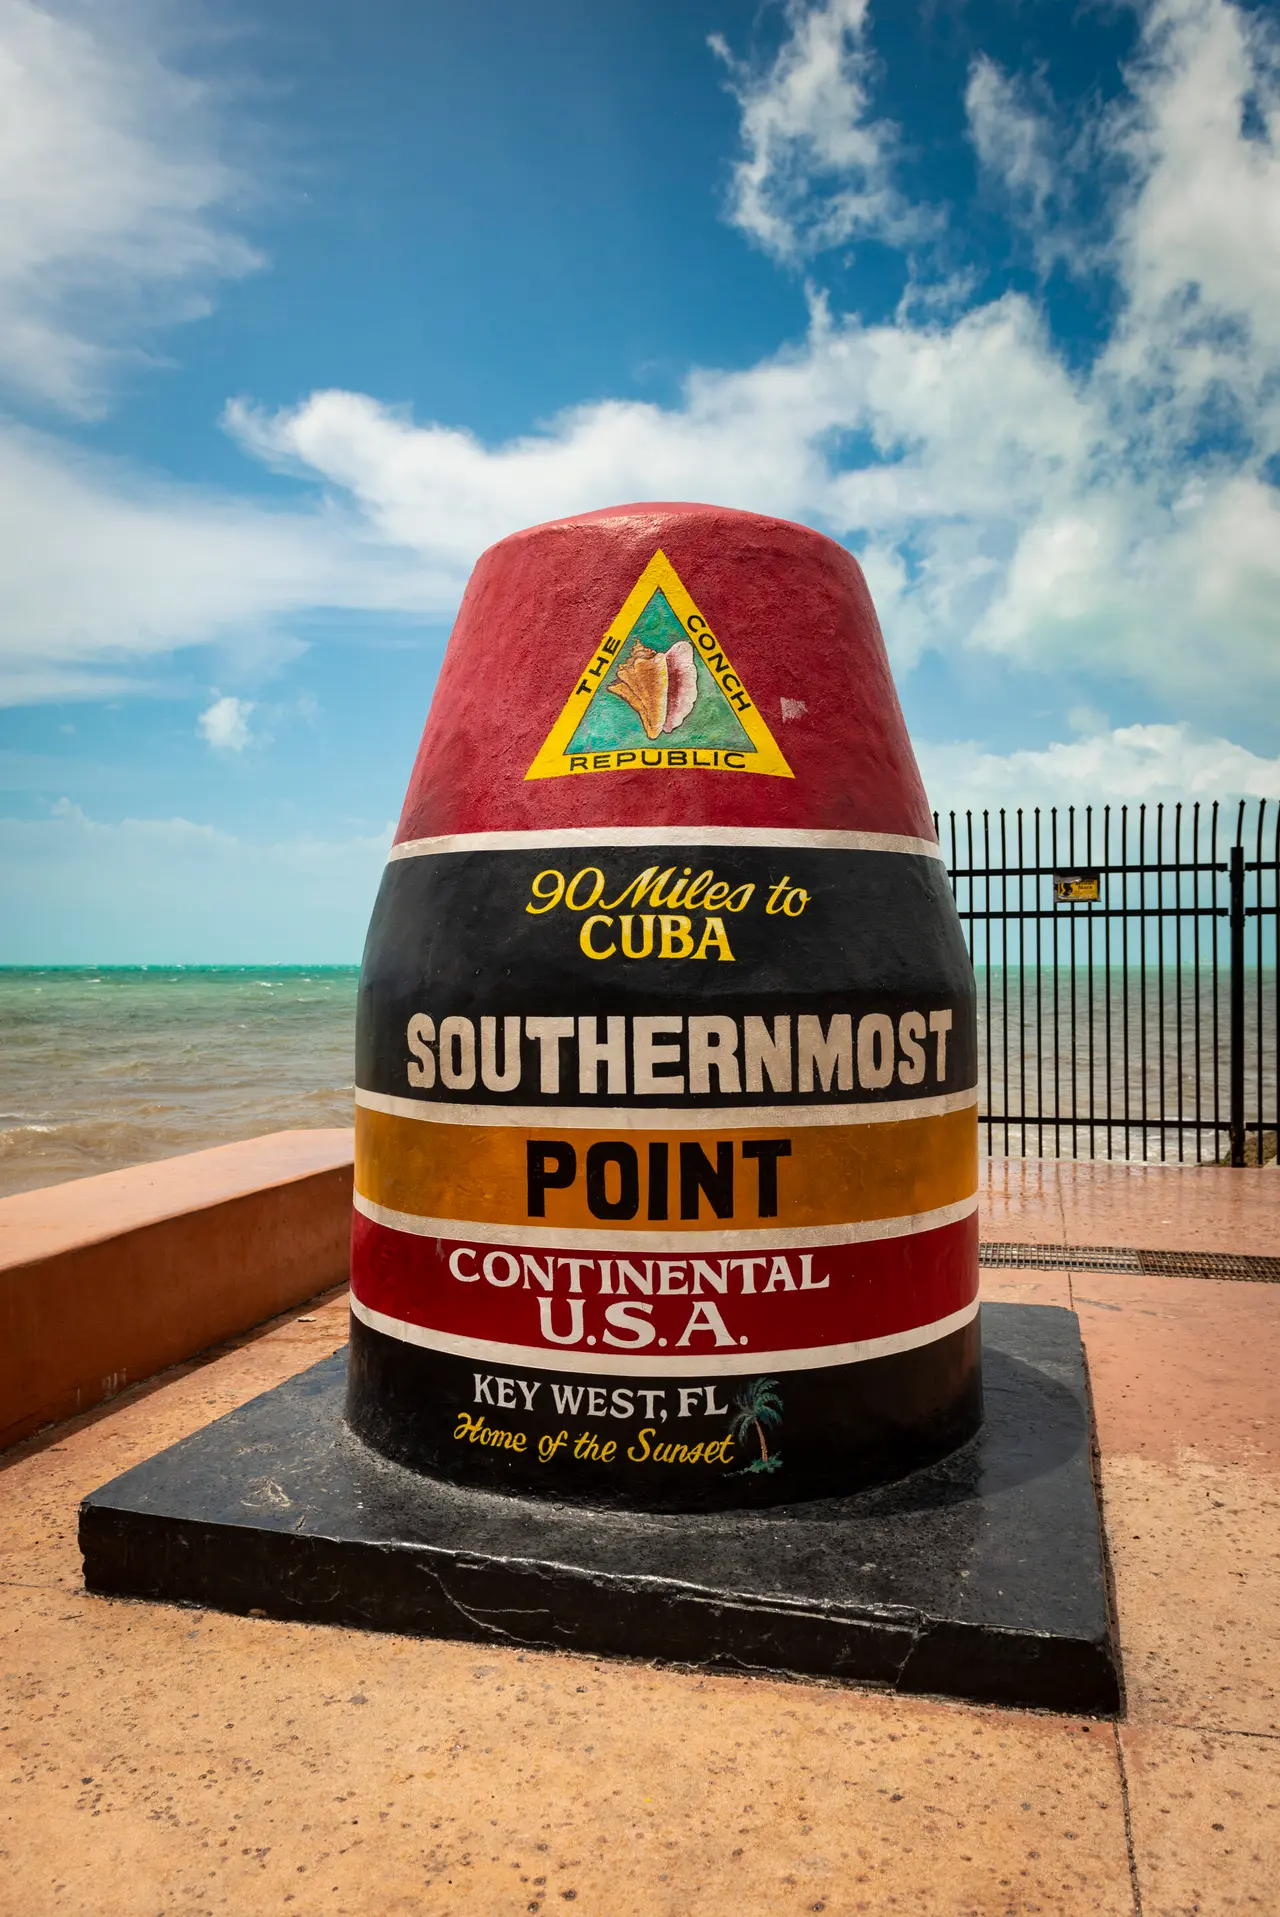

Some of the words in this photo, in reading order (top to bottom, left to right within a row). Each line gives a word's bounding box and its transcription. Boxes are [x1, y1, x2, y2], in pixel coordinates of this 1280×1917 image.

[575, 635, 621, 696] THE
[687, 614, 751, 713] CONCH
[569, 751, 746, 771] REPUBLIC
[525, 867, 605, 914] 90
[600, 866, 756, 912] Miles
[765, 876, 812, 917] to
[579, 914, 736, 962] CUBA
[406, 1009, 953, 1094] SOUTHERNMOST
[526, 1139, 792, 1220] POINT
[448, 1247, 830, 1295] CONTINENTAL
[537, 1297, 749, 1349] U.S.A.
[473, 1373, 542, 1411] KEY
[550, 1384, 667, 1423] WEST,
[677, 1385, 729, 1417] FL
[453, 1412, 528, 1452] Home
[537, 1430, 568, 1463] of
[573, 1431, 616, 1463] the
[627, 1428, 736, 1464] Sunset
